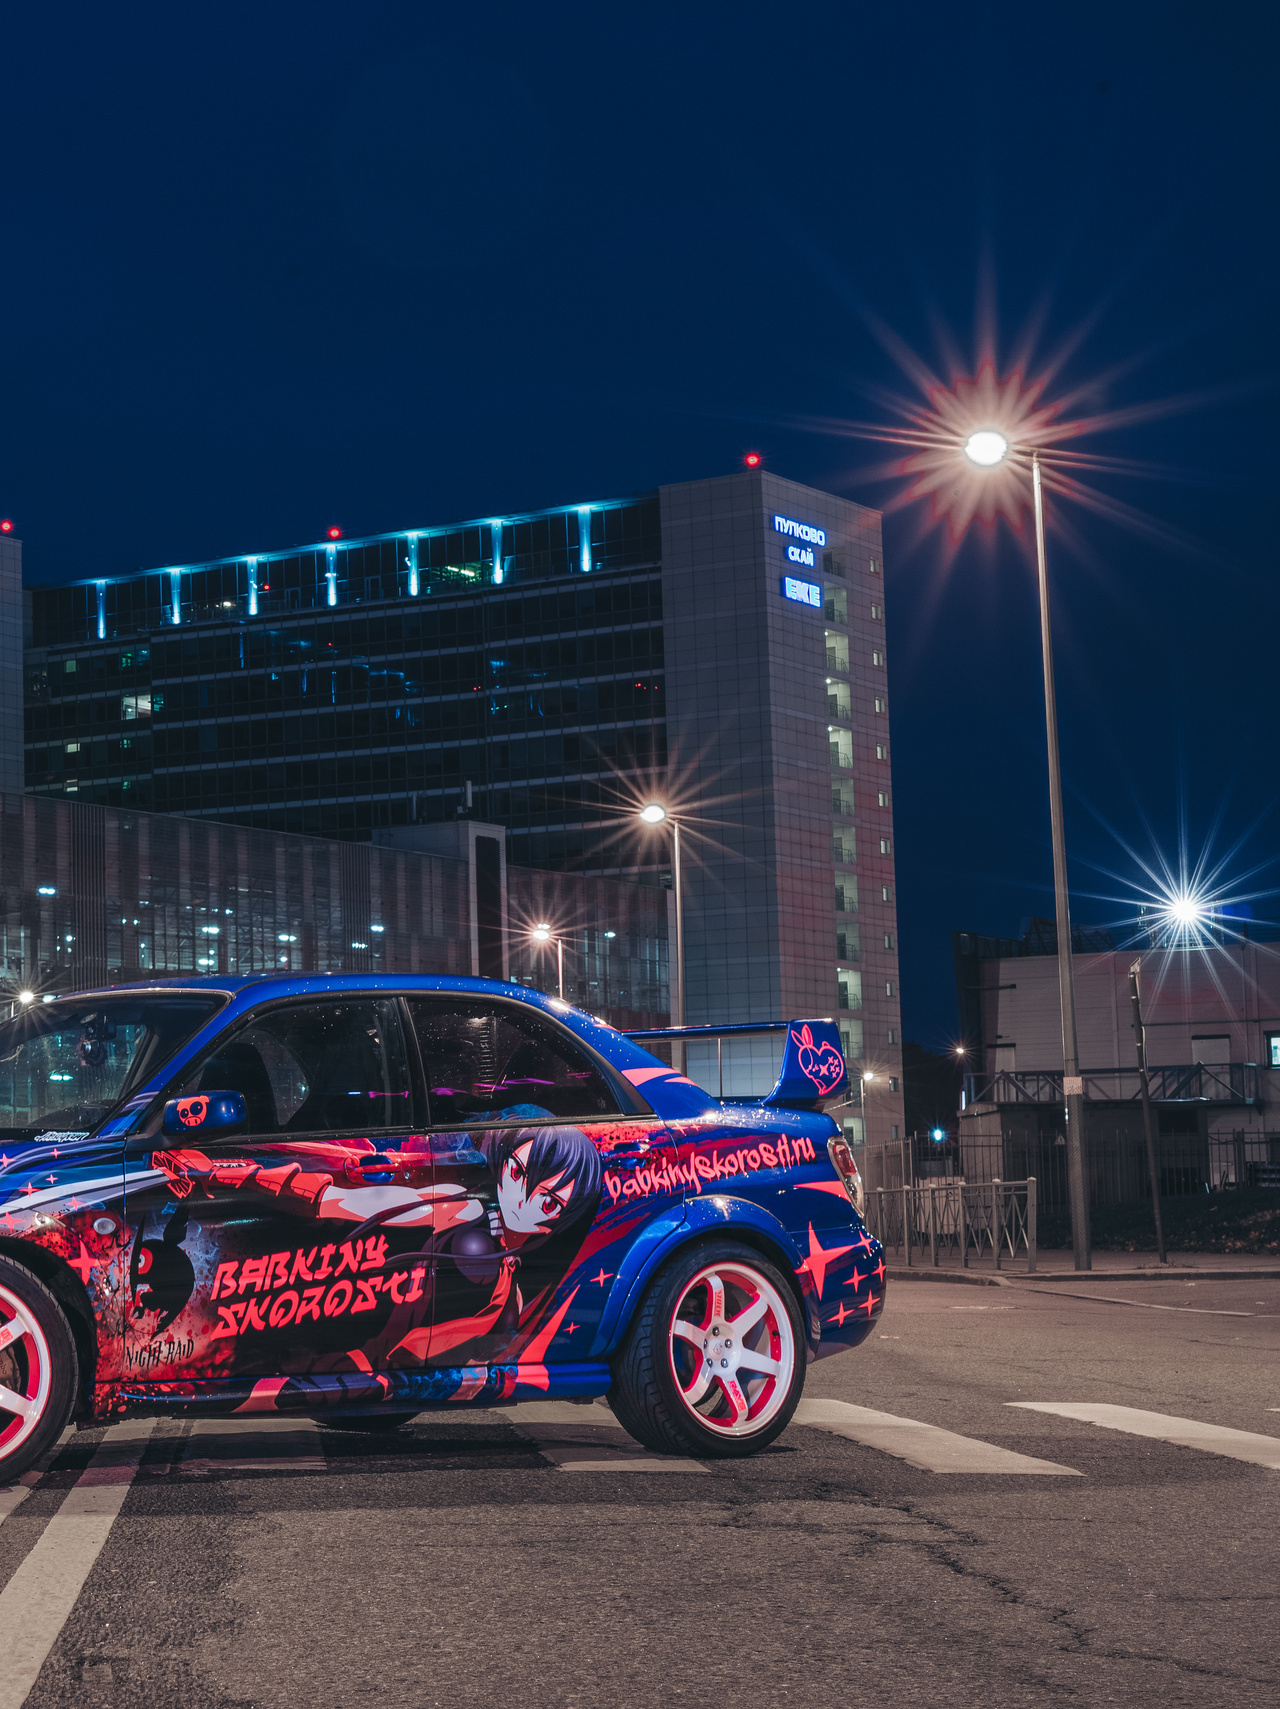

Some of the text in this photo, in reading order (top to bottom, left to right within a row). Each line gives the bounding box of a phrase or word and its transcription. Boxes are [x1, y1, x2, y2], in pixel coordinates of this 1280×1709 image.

[774, 515, 826, 546] ПУЛКОВО
[788, 546, 814, 566] СКАЙ
[210, 1233, 389, 1301] BABKINY
[210, 1266, 426, 1342] SKOROSTI
